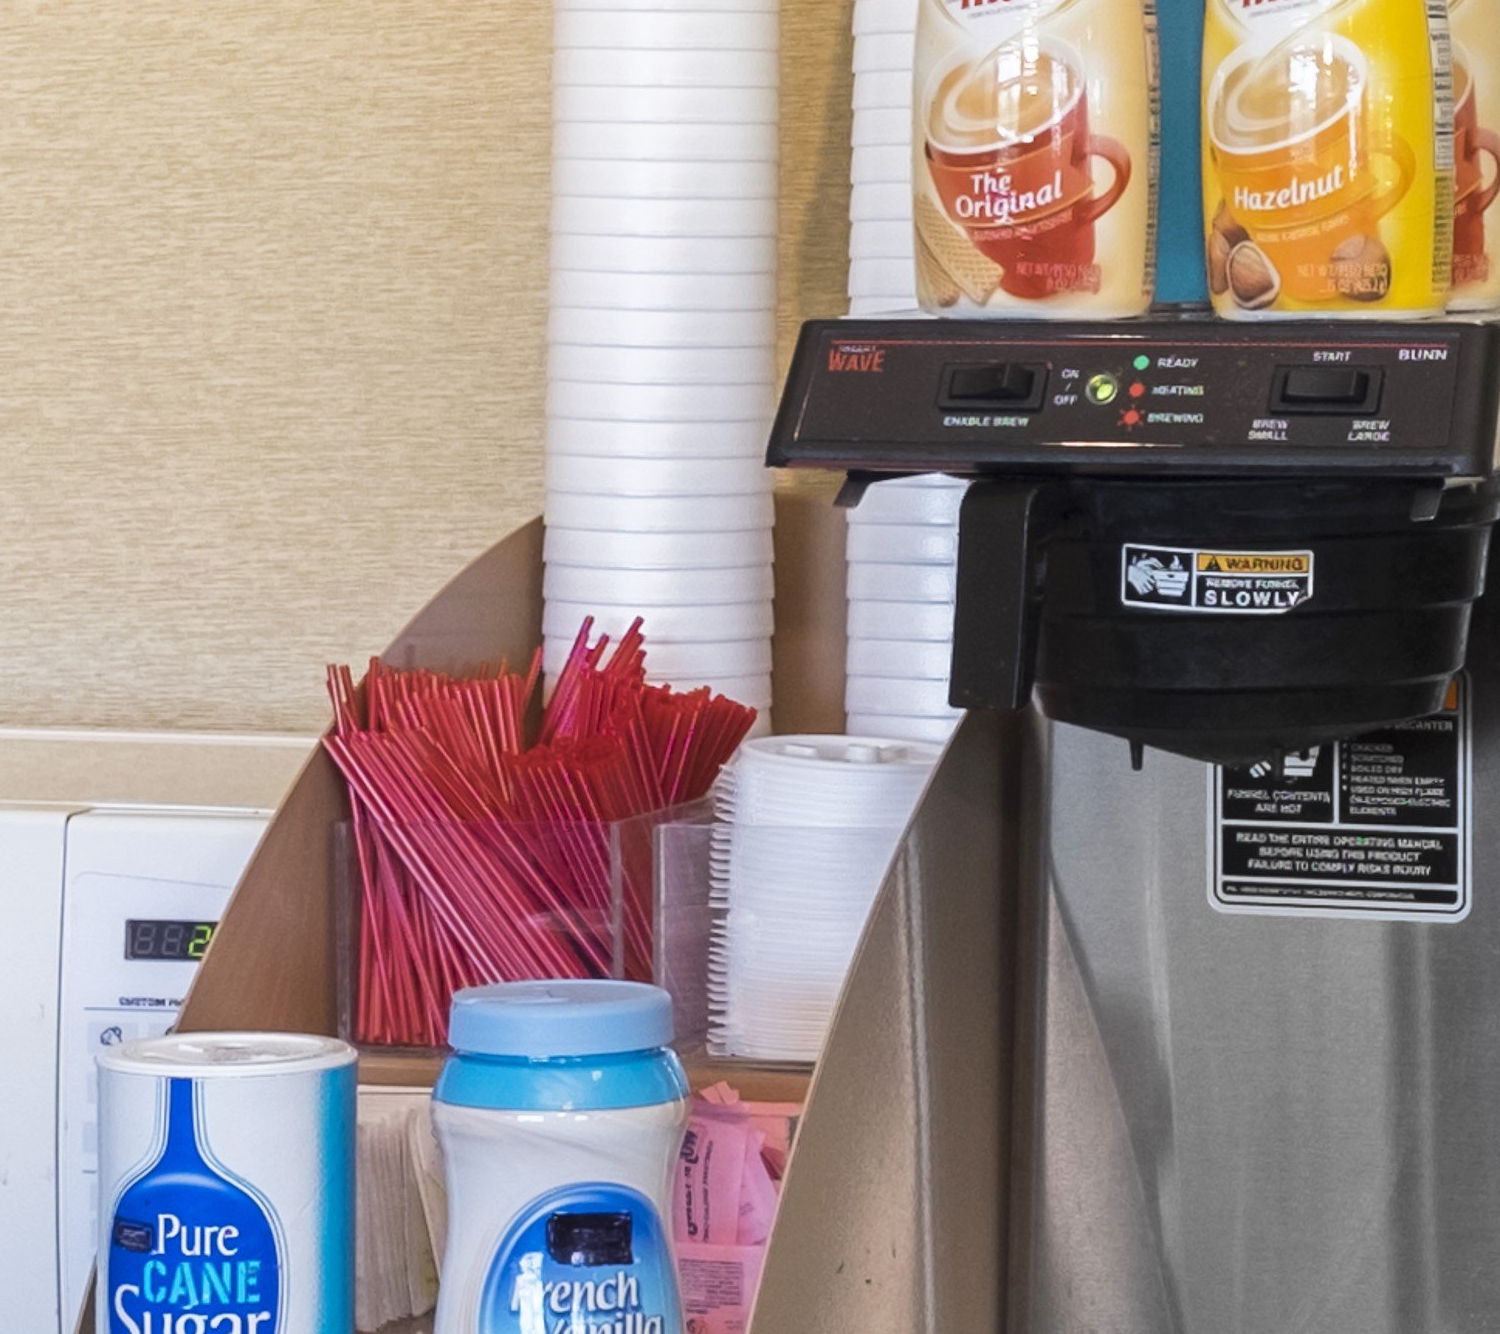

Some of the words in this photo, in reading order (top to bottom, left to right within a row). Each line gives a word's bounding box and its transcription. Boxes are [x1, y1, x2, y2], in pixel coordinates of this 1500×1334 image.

[971, 171, 1013, 196] The
[1233, 163, 1344, 212] Hazelnut
[955, 170, 1063, 223] Original
[829, 349, 885, 373] WAVE
[1157, 357, 1199, 368] READY
[1313, 351, 1352, 362] START
[1399, 349, 1447, 361] BUNN
[1061, 369, 1080, 379] ON
[1053, 395, 1078, 406] OFF
[943, 417, 990, 427] ENABLE
[1225, 557, 1304, 572] WARNING
[1204, 590, 1301, 607] SLOWLY
[1236, 832, 1266, 843] READ
[151, 1213, 240, 1256] Pure
[143, 1260, 261, 1304] CANE
[511, 1270, 639, 1313] rench
